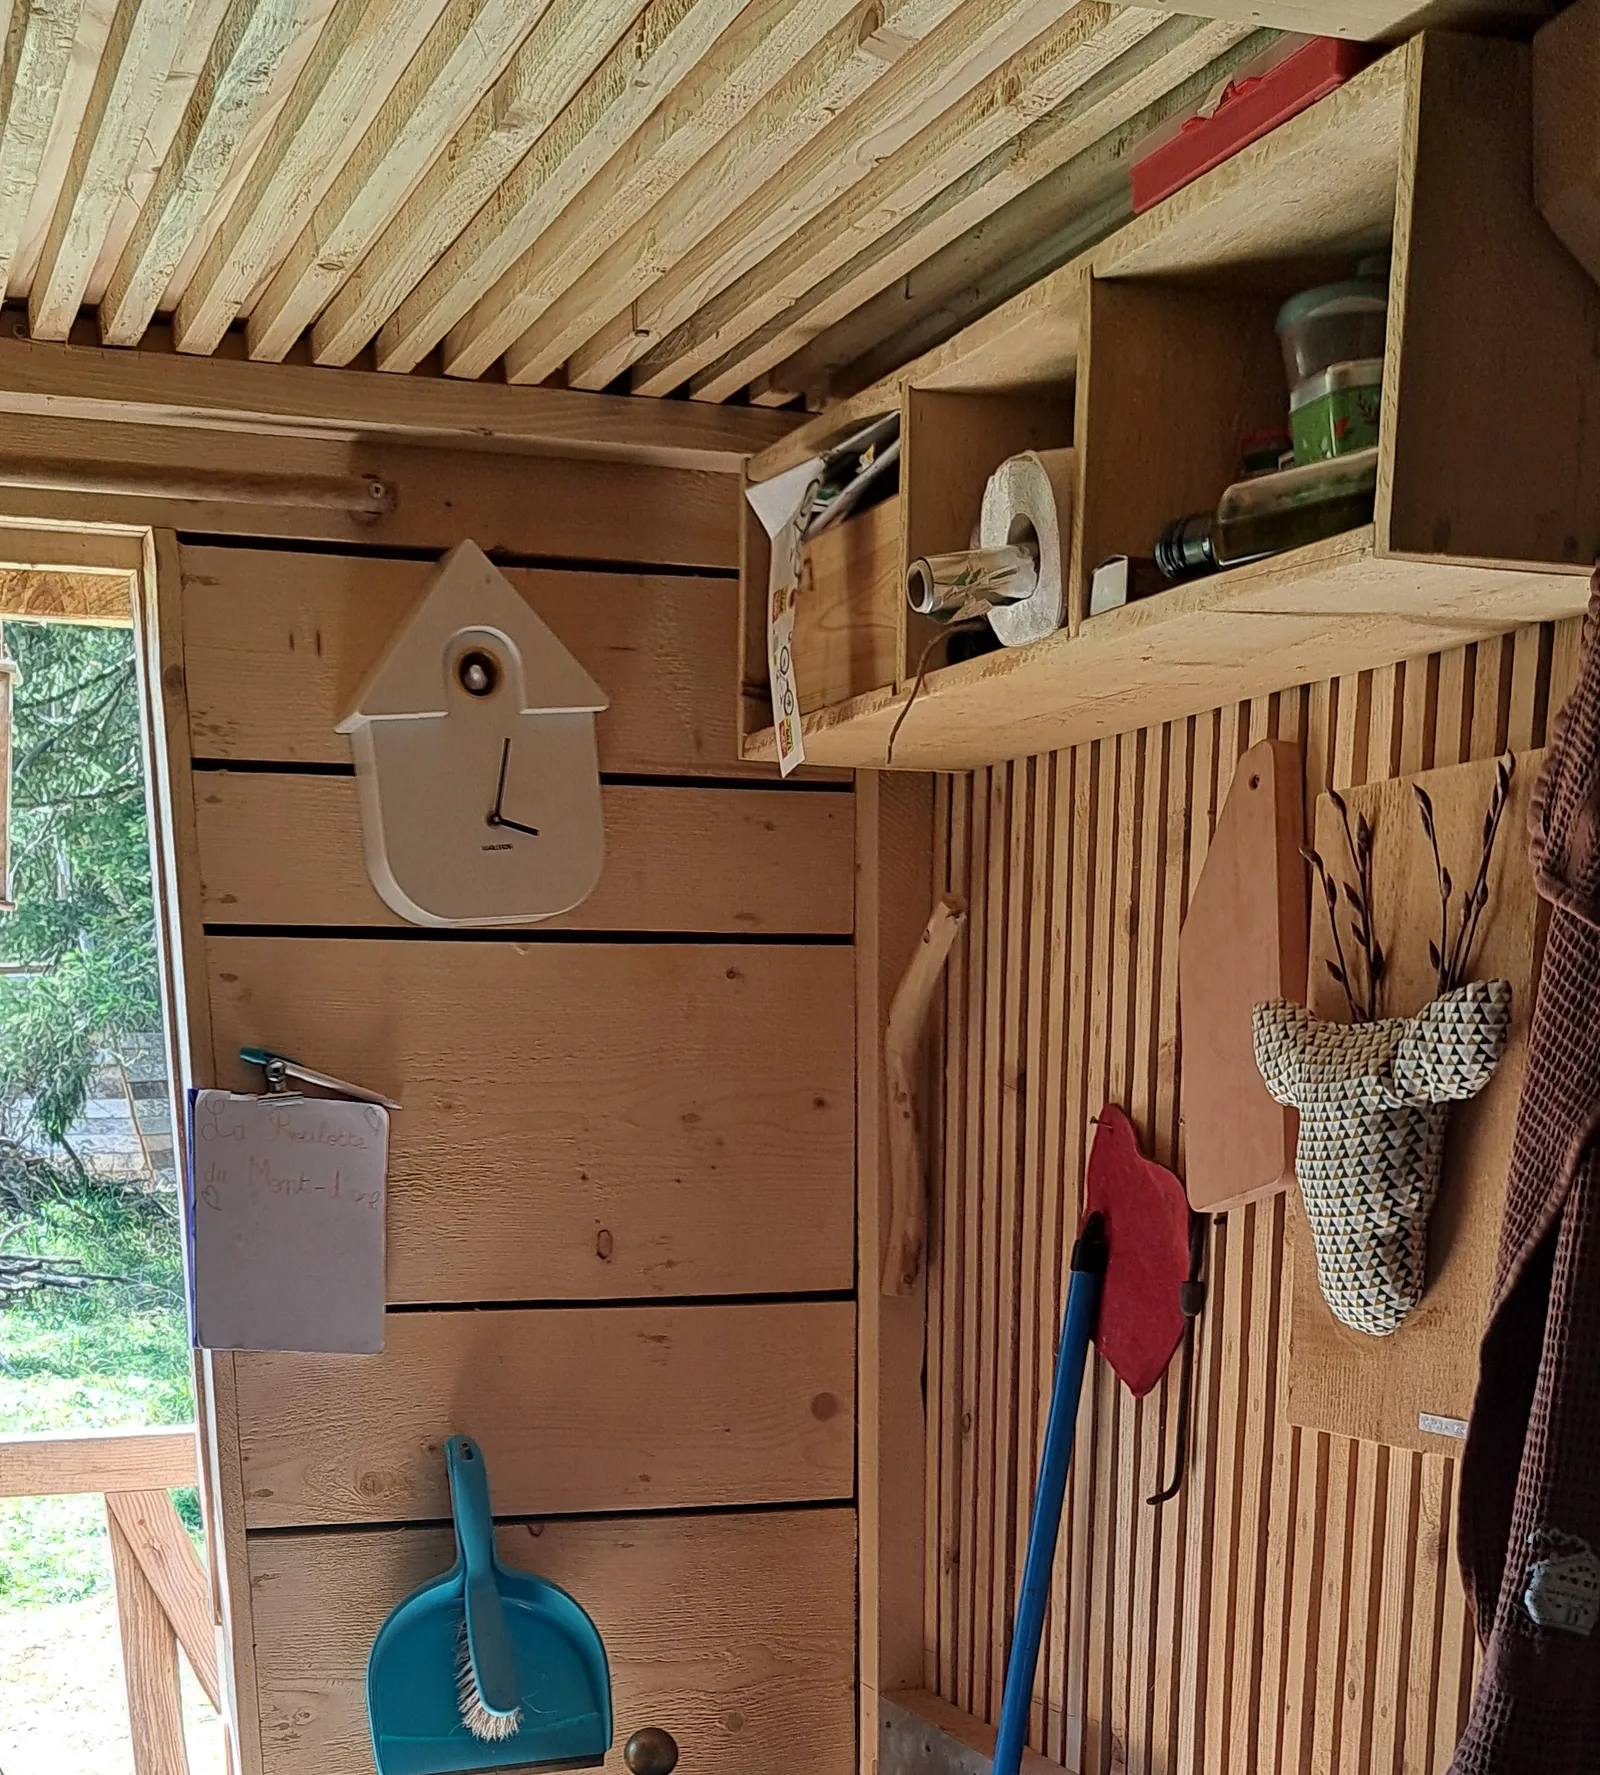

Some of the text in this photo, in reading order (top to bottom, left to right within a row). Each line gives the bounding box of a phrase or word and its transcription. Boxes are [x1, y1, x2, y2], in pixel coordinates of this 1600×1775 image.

[201, 1099, 370, 1150] La Roulotte
[204, 1161, 229, 1184] du
